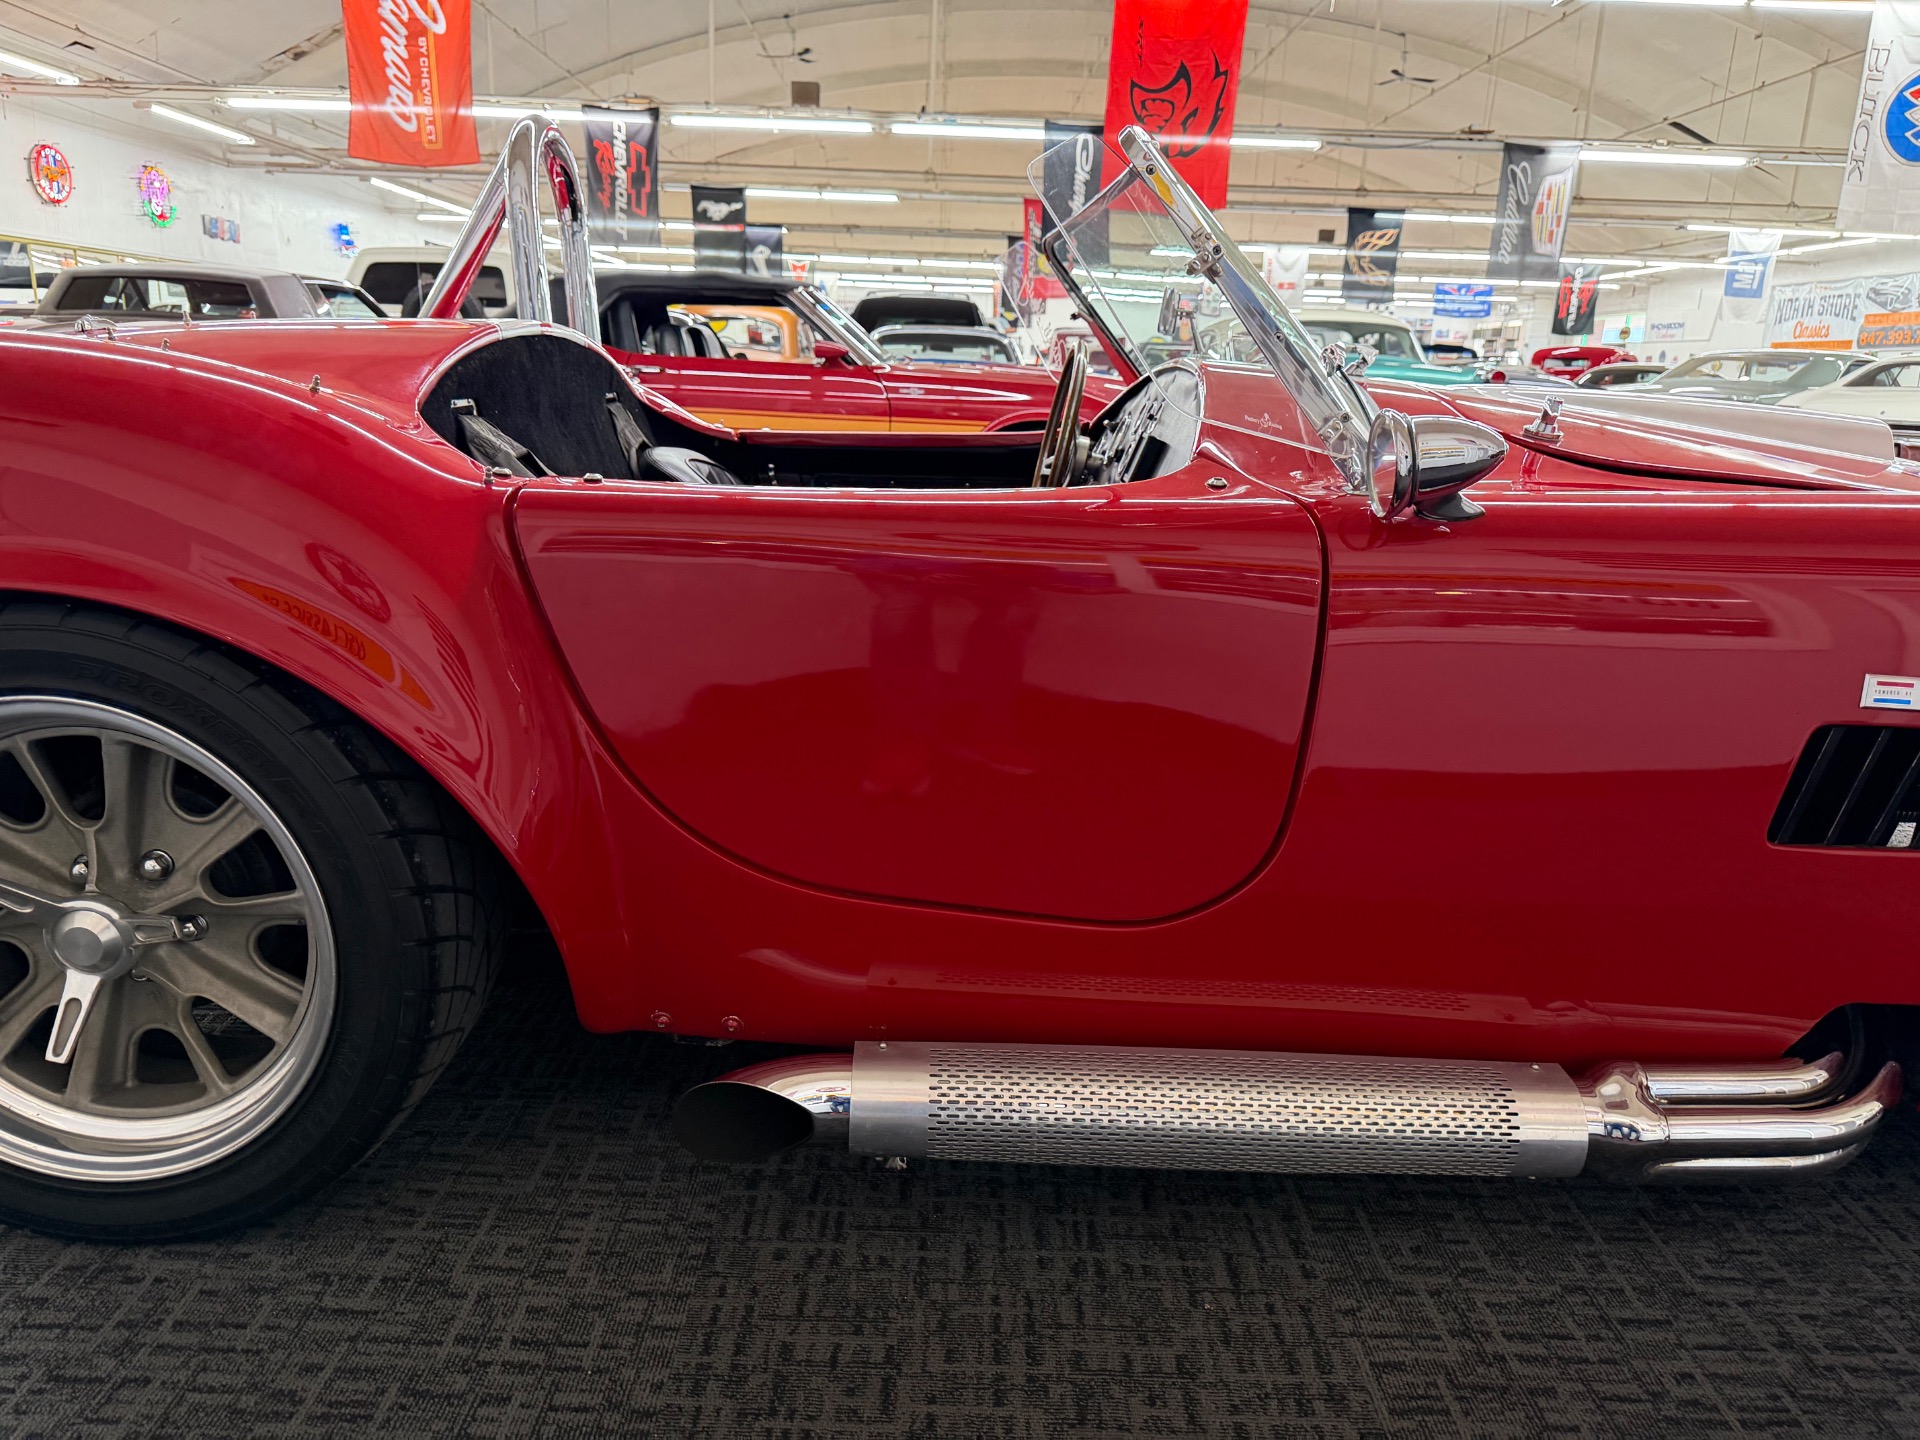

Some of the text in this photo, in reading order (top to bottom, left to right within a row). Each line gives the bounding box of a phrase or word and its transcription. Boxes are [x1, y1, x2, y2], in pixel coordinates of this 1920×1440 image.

[417, 36, 437, 142] BY CHEVROLET
[1847, 38, 1894, 183] BUICK
[40, 147, 62, 161] FORD
[612, 120, 629, 241] CHEVROLET
[1497, 160, 1533, 265] Cadillac
[1773, 296, 1816, 326] NORTH
[1817, 292, 1862, 322] SHORE
[1792, 319, 1831, 340] Classics
